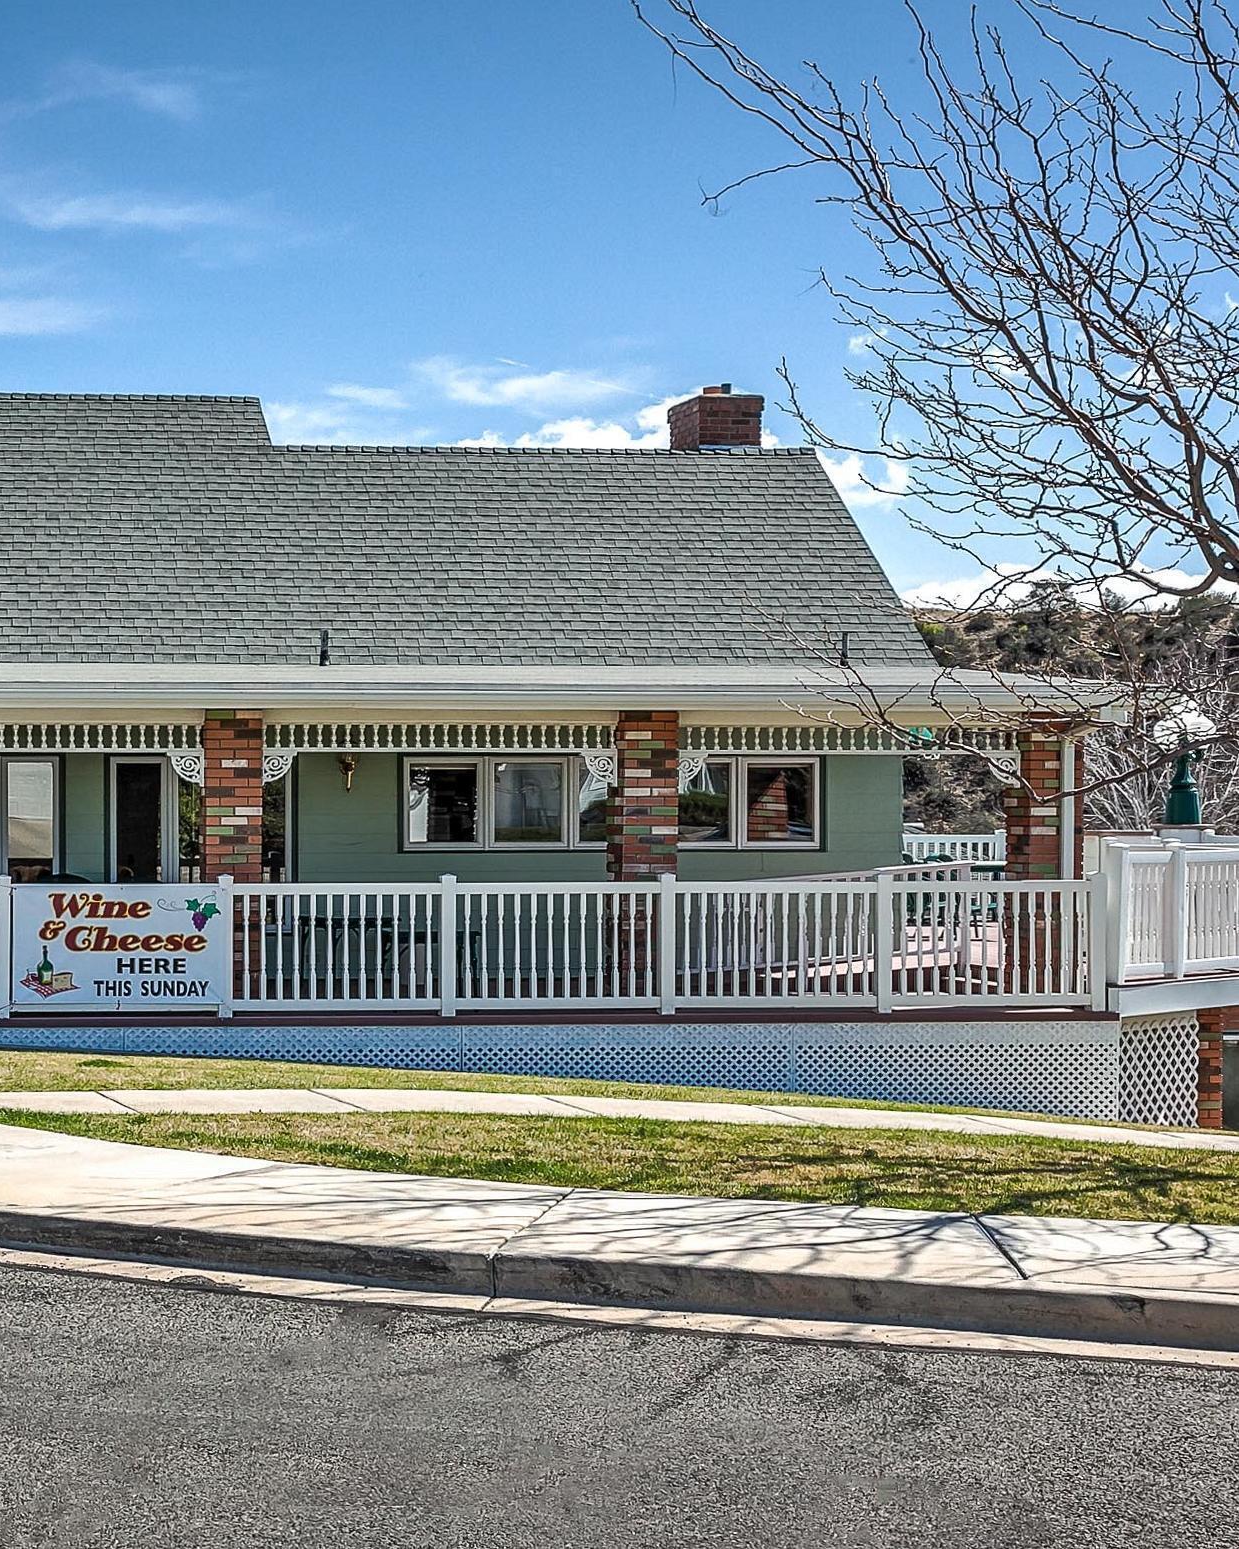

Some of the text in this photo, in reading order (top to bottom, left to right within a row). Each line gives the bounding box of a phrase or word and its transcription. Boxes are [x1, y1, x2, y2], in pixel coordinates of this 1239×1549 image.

[48, 891, 152, 919] Wine
[38, 920, 209, 952] & Cheese
[116, 957, 187, 974] HERE
[93, 980, 210, 997] THIS SUNDAY
